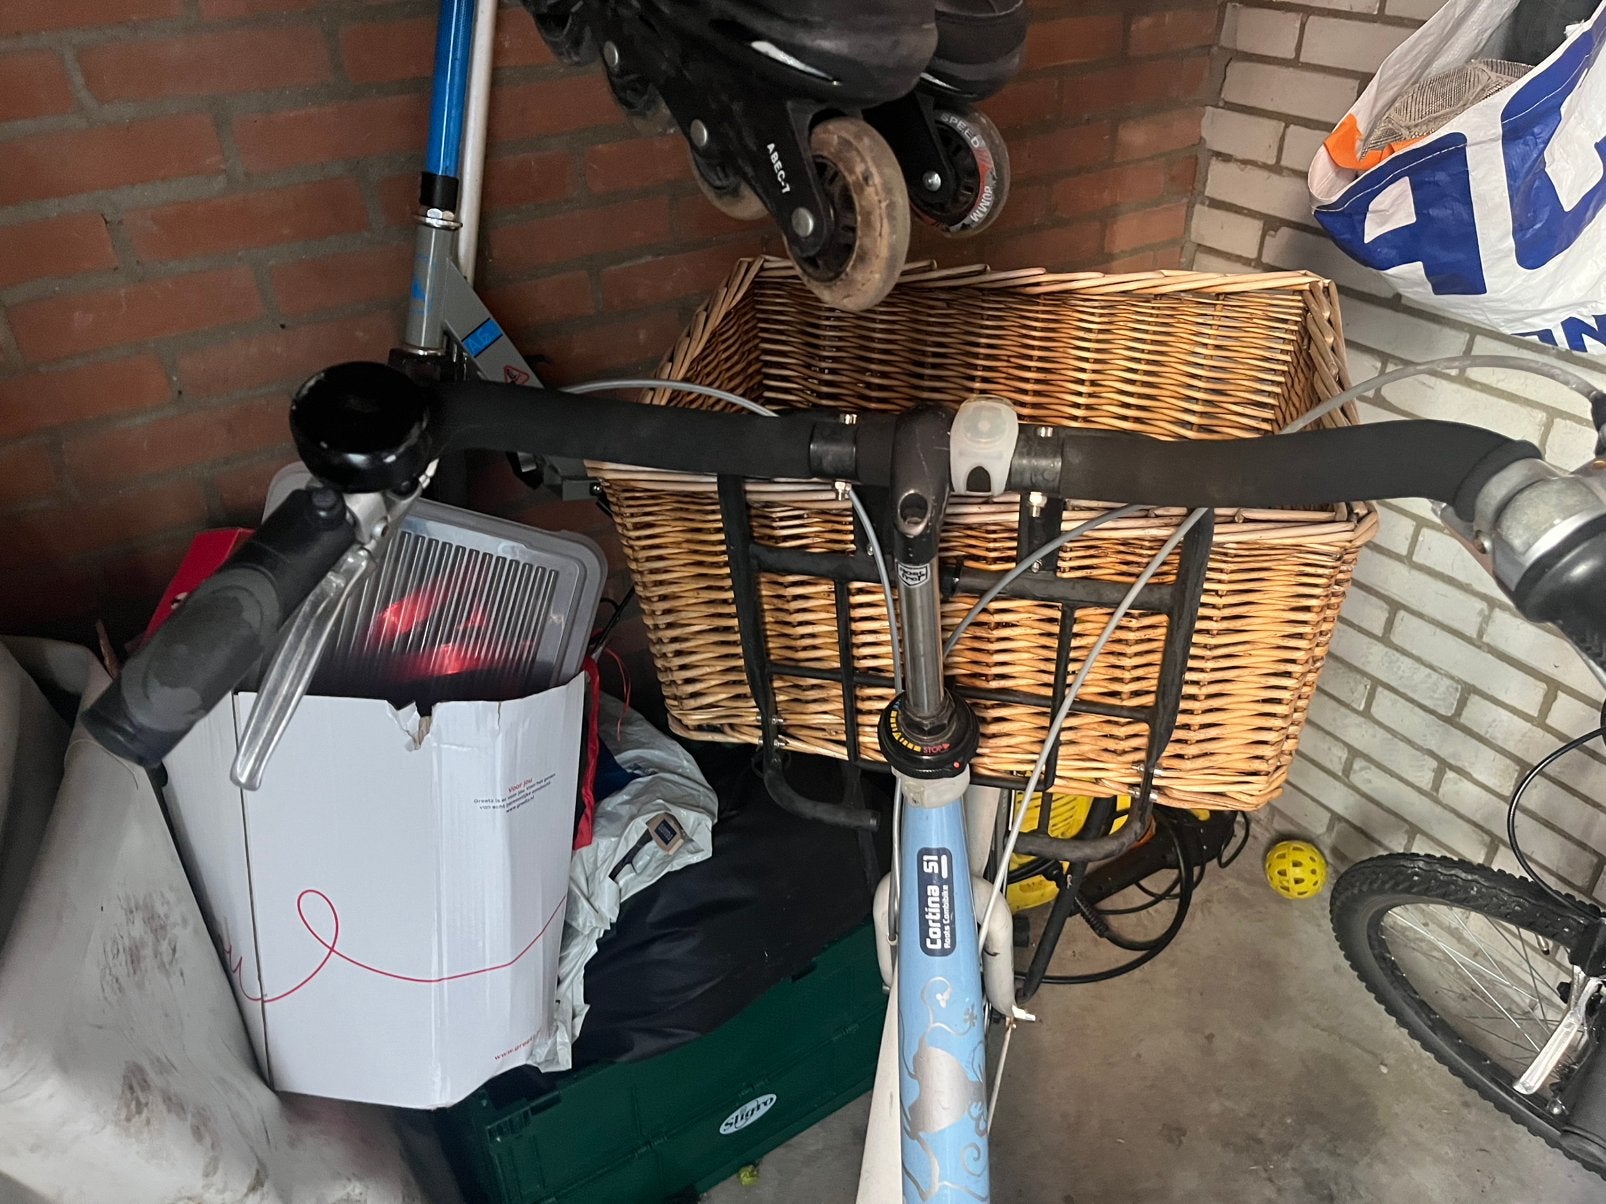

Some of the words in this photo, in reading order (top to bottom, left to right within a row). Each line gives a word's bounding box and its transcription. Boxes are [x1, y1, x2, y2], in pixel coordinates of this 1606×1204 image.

[940, 111, 980, 149] SPEED
[923, 744, 942, 754] STOP
[925, 885, 942, 950] Cortina
[722, 1096, 774, 1132] Sligro
